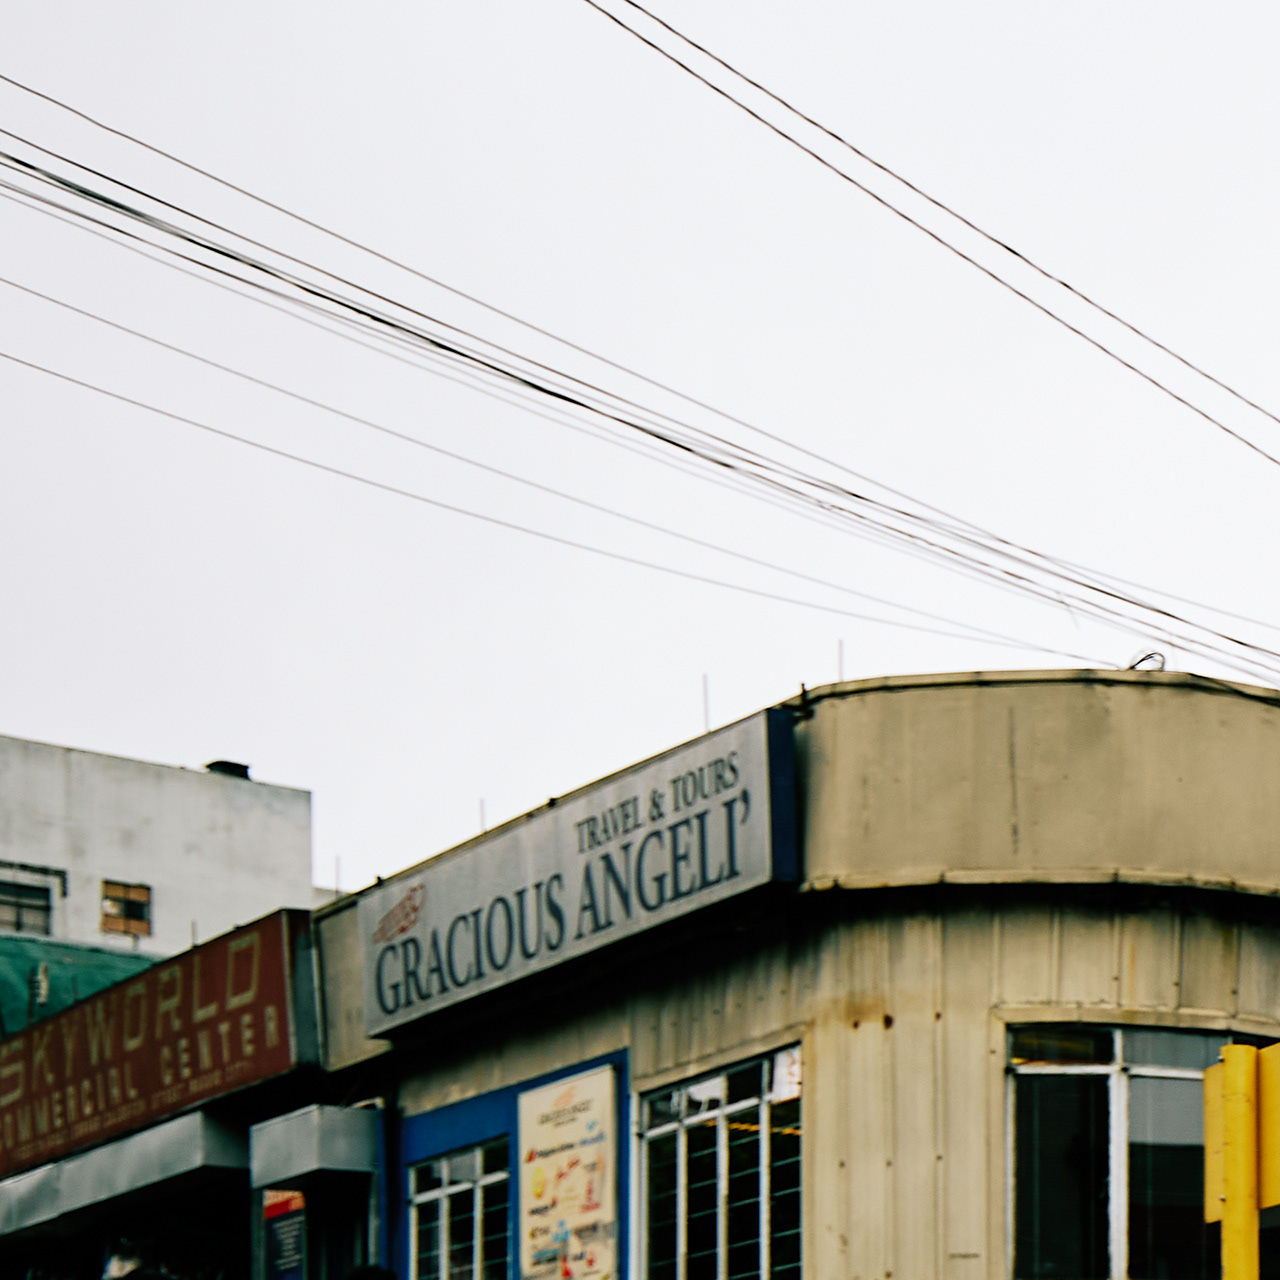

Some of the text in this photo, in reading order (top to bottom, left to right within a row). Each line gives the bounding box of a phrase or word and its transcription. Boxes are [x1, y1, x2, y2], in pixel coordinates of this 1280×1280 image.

[575, 750, 740, 854] TRAVEL & TOURS
[376, 872, 565, 1017] GRACIOUS
[0, 930, 261, 1107] SKYWORLD
[0, 1061, 138, 1149] OMMERCIAL
[160, 1004, 280, 1087] CENTER
